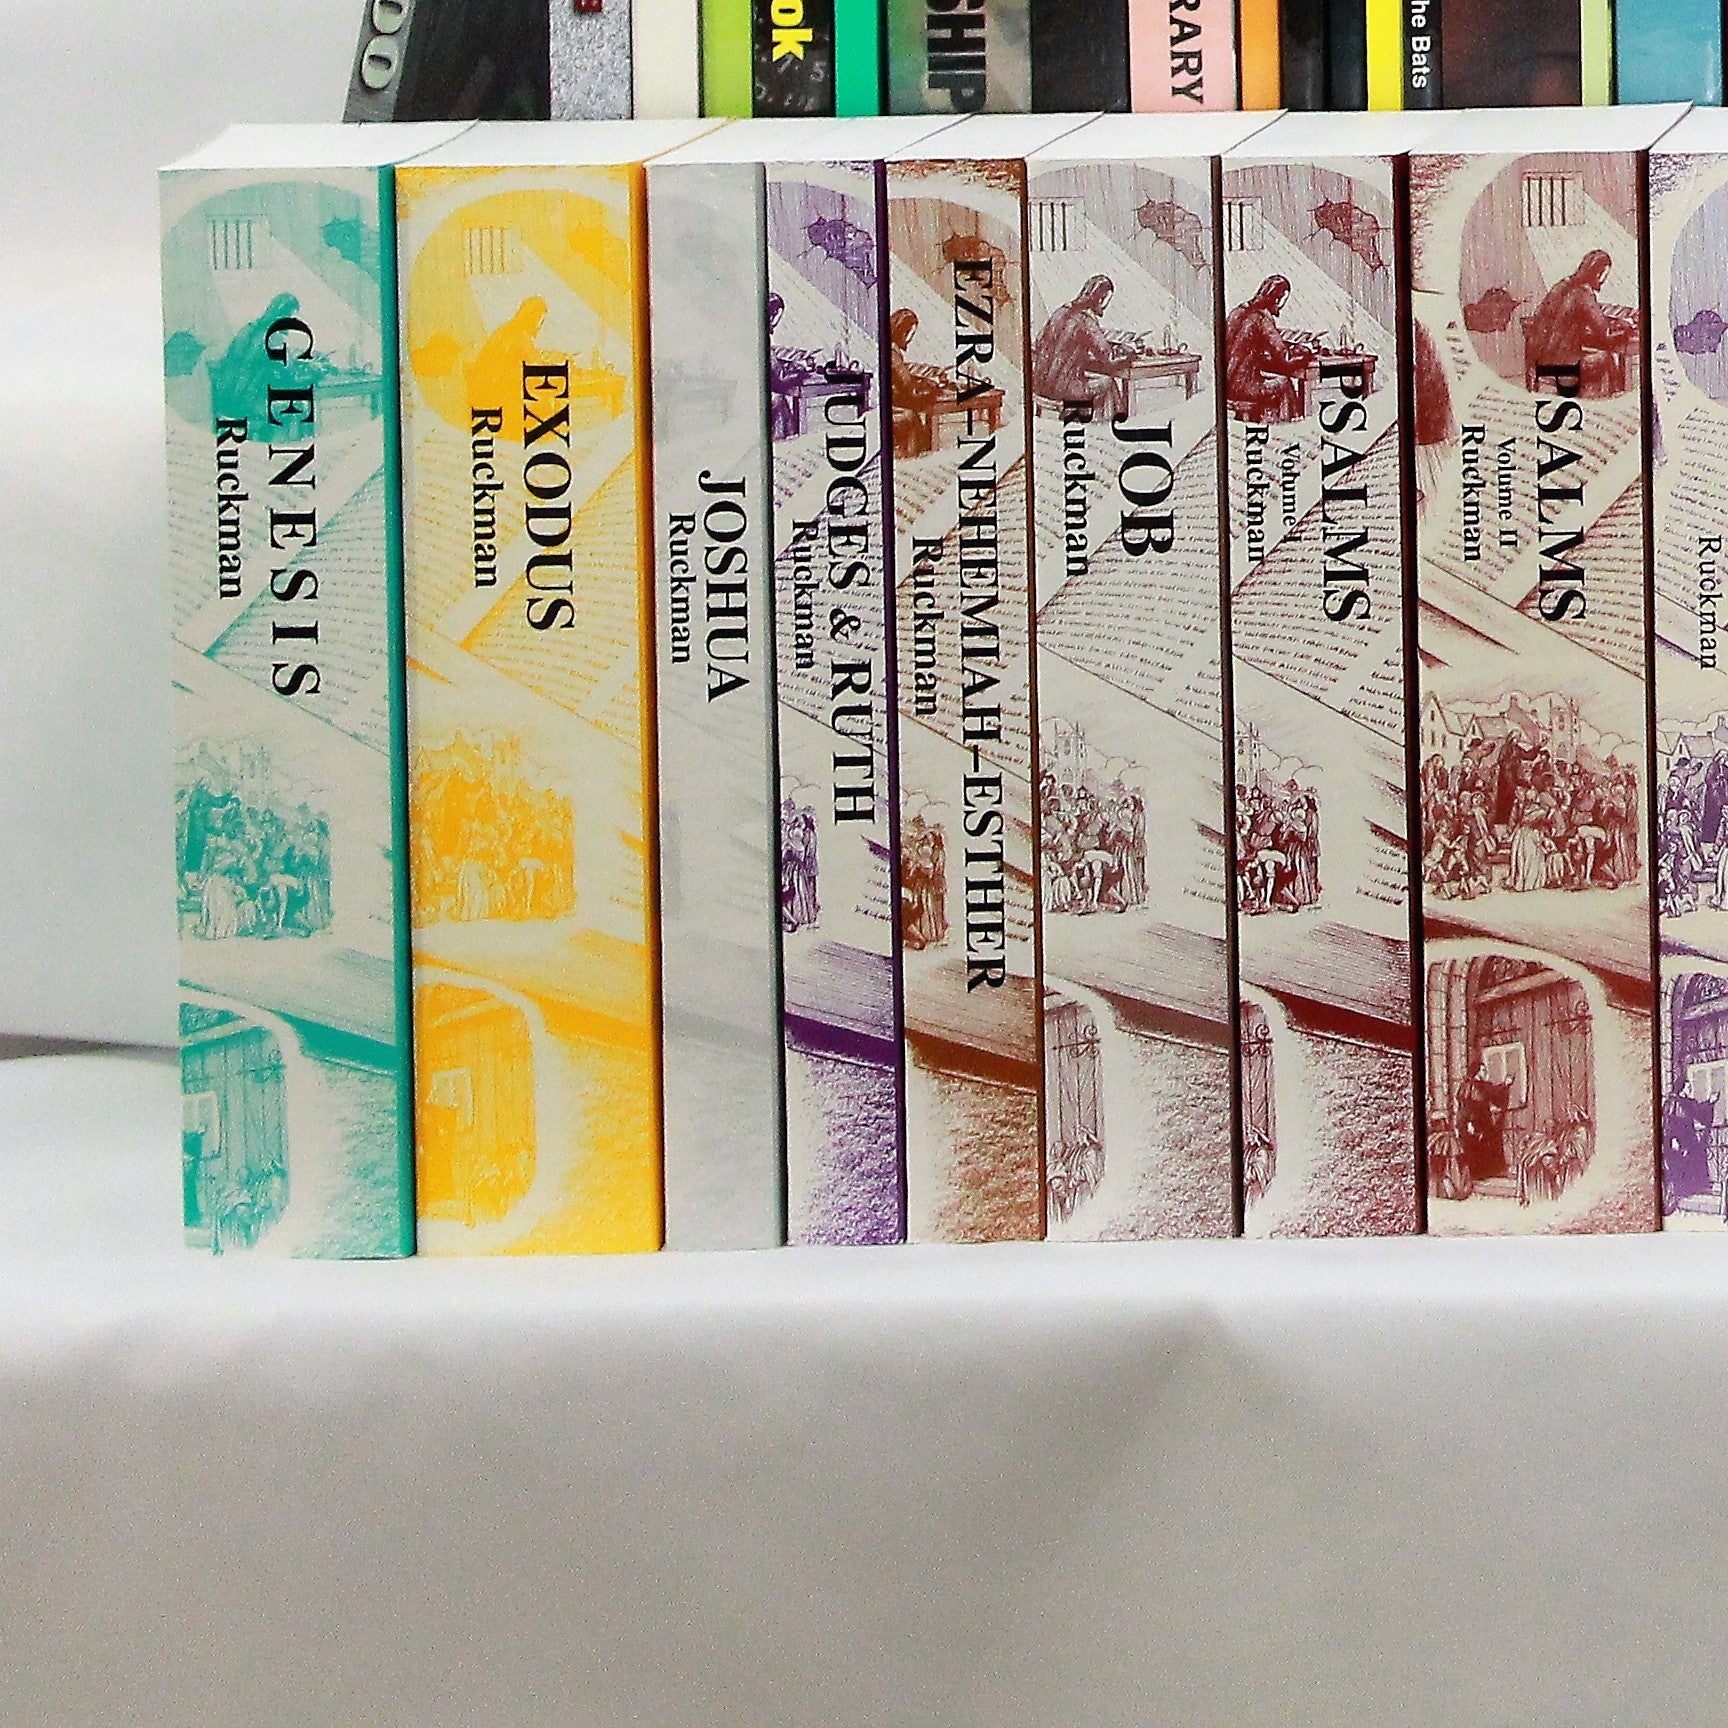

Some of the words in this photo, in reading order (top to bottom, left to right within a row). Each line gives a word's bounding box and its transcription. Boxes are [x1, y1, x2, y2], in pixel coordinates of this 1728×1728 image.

[215, 416, 247, 600] Ruckman
[471, 407, 503, 588] Ruckman
[521, 360, 574, 632] EXODUS
[823, 361, 869, 587] JUDGES
[1112, 412, 1175, 557] JOB
[1319, 365, 1371, 623] PSALMS
[1460, 424, 1483, 562] Ruckman
[1497, 437, 1516, 522] Volume
[1500, 530, 1518, 547] II
[1535, 363, 1588, 624] PSALMS
[669, 512, 696, 664] Ruckman
[698, 470, 750, 702] JOSHUA
[829, 609, 865, 640] &
[829, 659, 875, 825] RUTH
